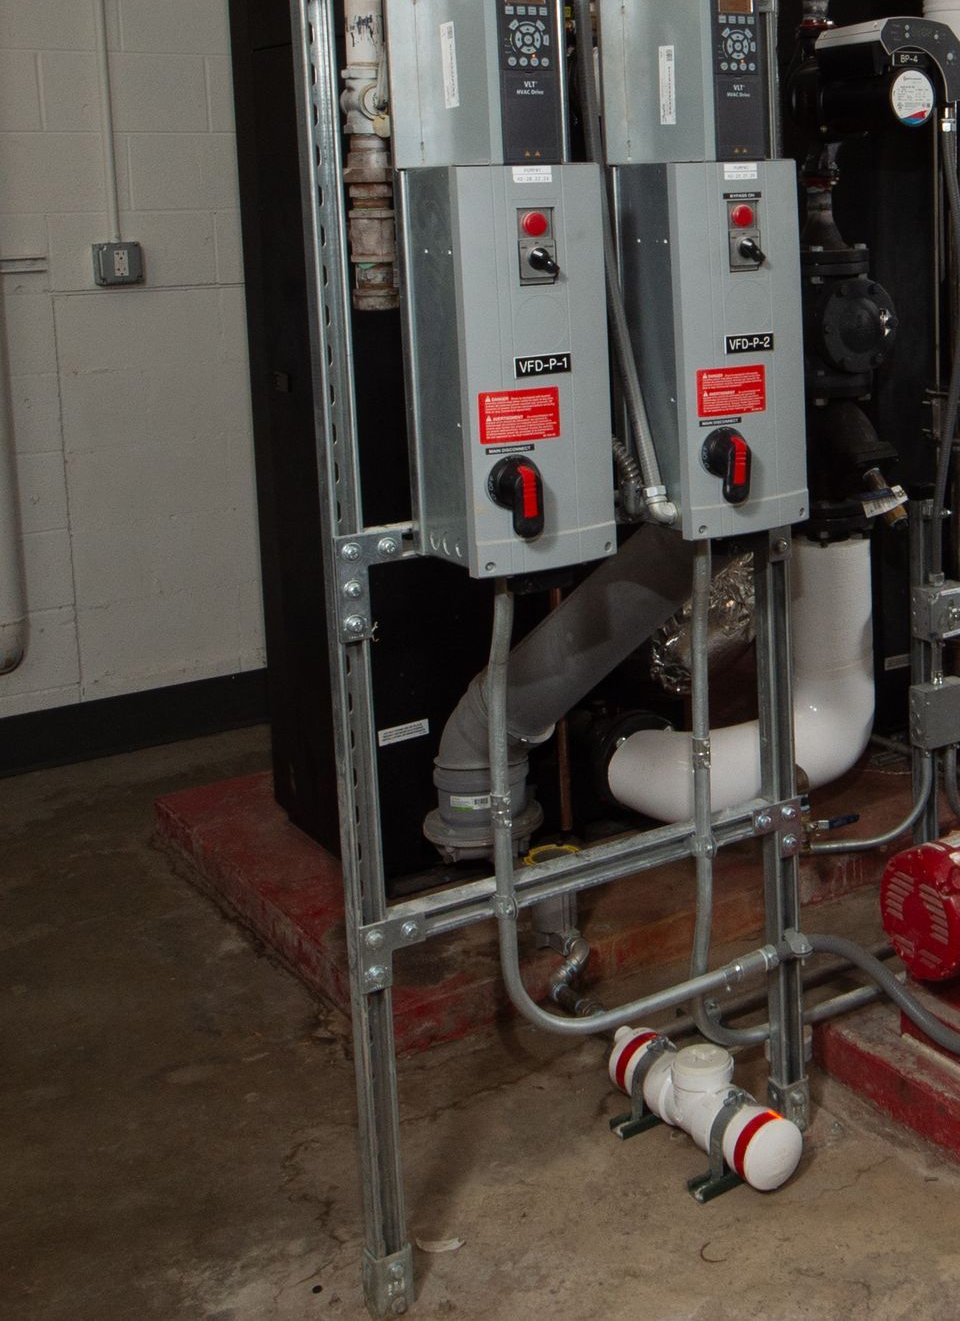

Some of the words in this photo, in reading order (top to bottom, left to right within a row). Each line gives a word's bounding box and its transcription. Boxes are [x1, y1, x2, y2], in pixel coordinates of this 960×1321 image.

[900, 54, 919, 64] BP-4
[728, 336, 771, 351] VFD-P-2
[518, 356, 568, 374] VFD-P-1
